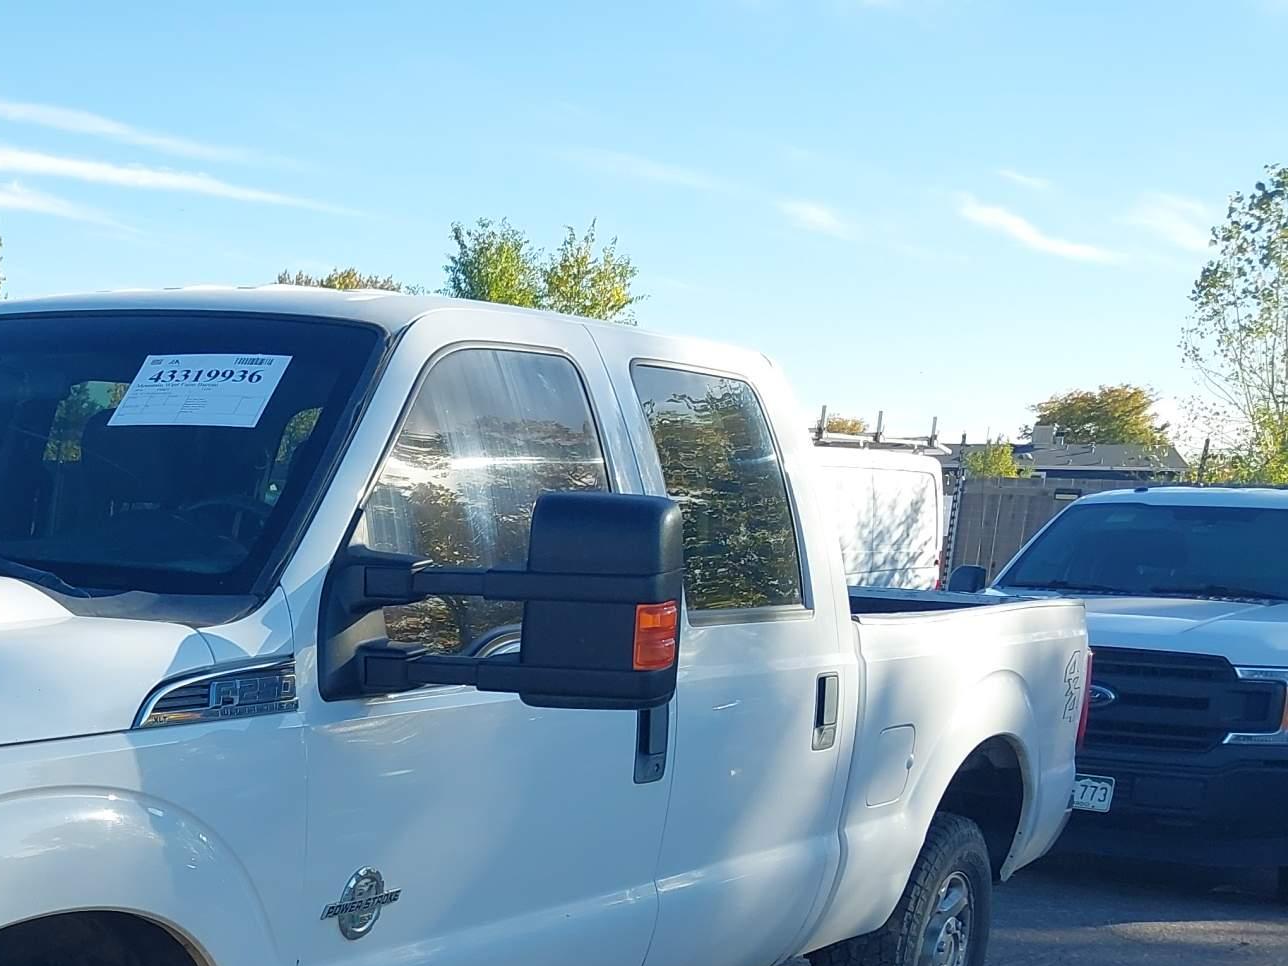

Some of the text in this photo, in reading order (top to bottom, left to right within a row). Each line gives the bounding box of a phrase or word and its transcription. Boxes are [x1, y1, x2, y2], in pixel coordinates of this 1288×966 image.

[148, 369, 264, 384] 43319936
[325, 899, 362, 919] POWER
[362, 888, 400, 910] STROKE
